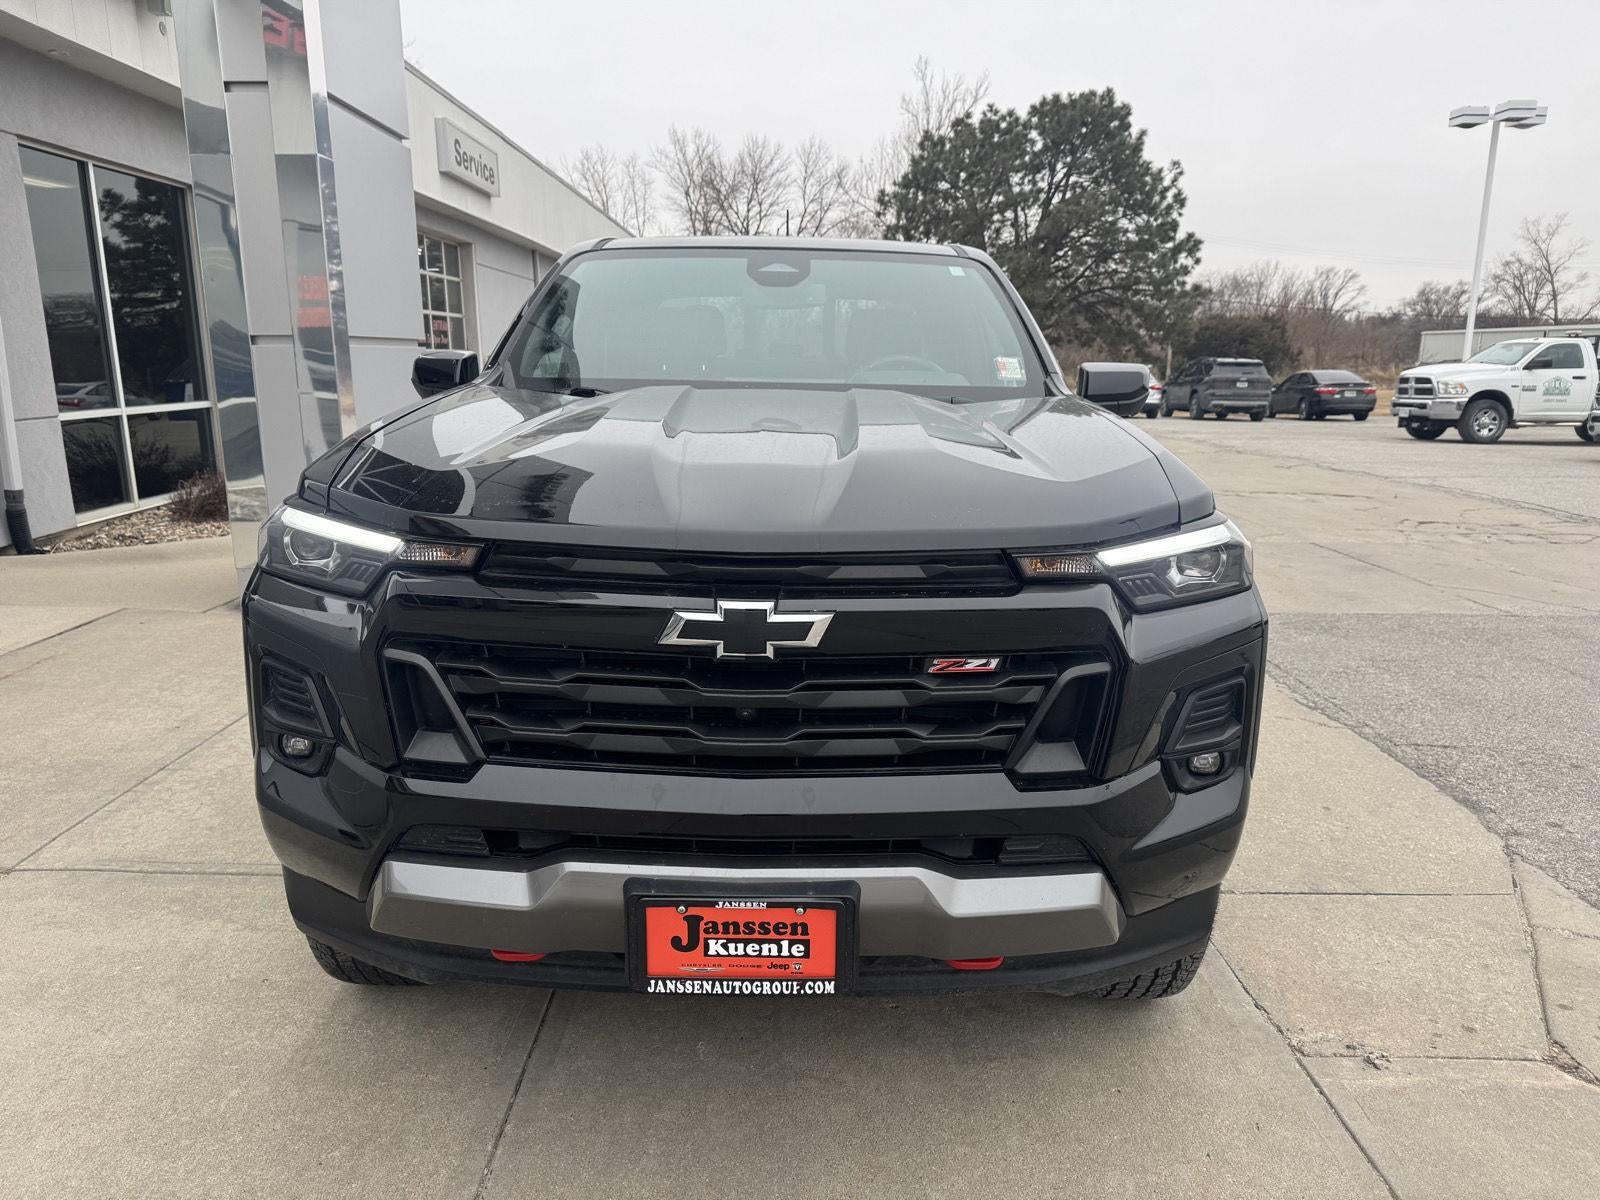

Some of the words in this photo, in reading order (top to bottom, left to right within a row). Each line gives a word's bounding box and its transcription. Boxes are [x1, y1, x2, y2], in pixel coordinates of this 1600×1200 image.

[454, 138, 495, 185] Service
[928, 658, 1000, 673] Z71
[715, 901, 767, 909] JANSSEN
[670, 914, 810, 953] Janssen
[707, 939, 805, 957] Kuenle
[767, 962, 790, 971] Jeep
